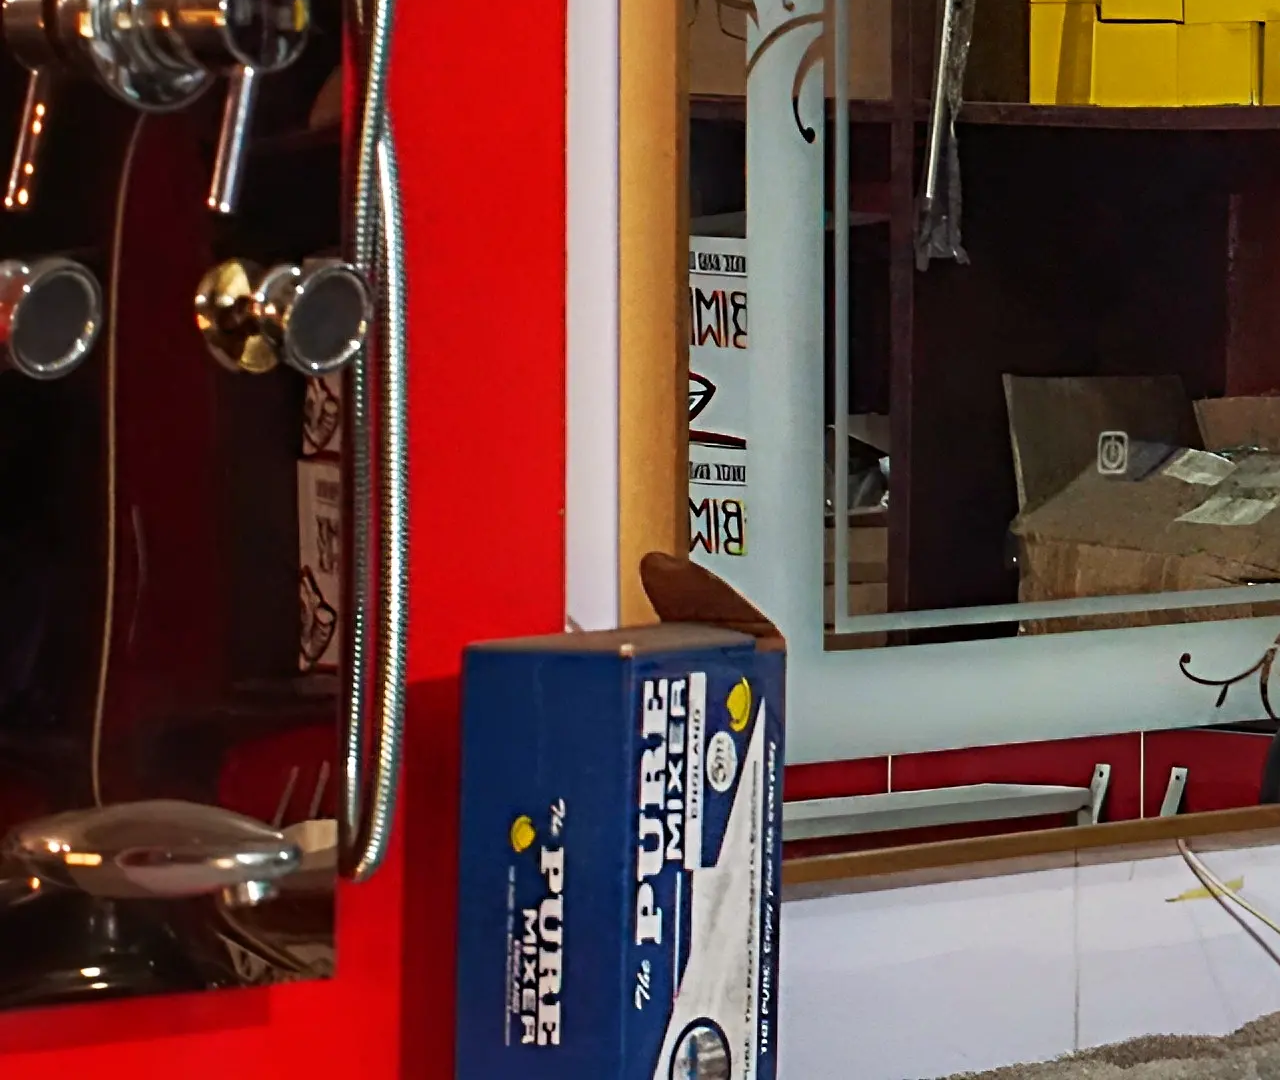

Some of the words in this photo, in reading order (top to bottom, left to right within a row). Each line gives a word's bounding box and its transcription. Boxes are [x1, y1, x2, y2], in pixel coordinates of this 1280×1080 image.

[635, 678, 668, 946] PURE
[666, 679, 687, 860] MIXER
[690, 708, 701, 819] ENGLAND
[520, 908, 538, 1045] MIXER
[537, 845, 564, 1046] PURE
